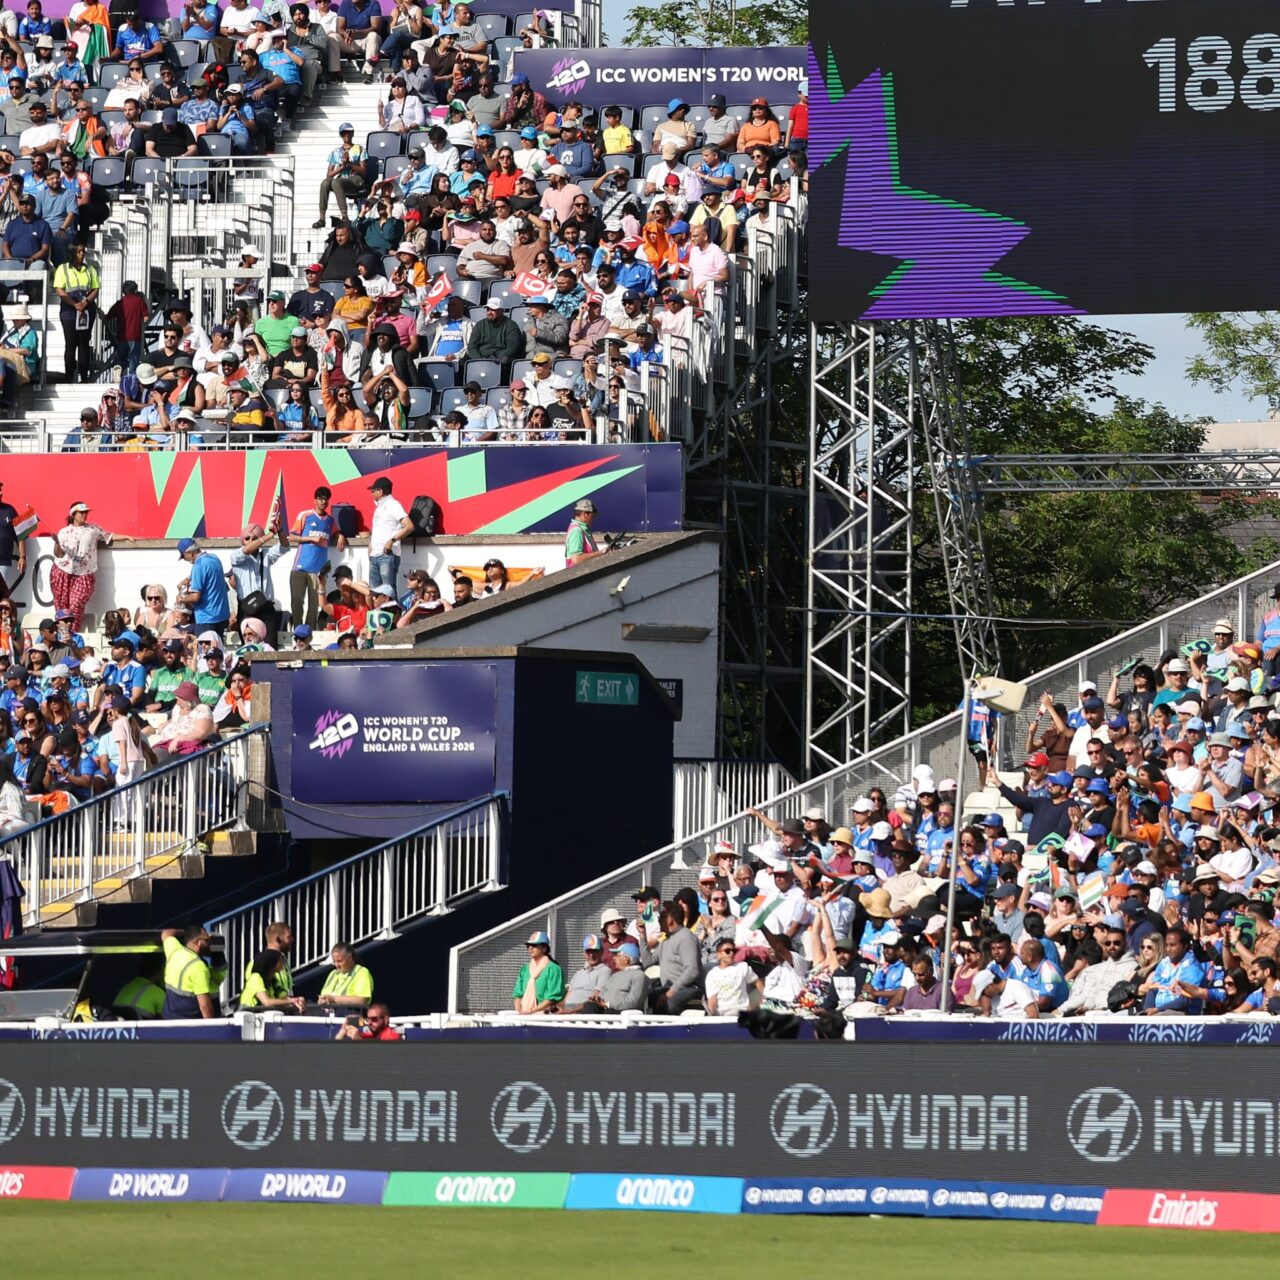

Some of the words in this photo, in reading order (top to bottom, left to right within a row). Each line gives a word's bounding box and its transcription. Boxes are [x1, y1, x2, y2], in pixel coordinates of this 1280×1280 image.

[596, 68, 626, 83] ICC
[630, 67, 717, 83] WOMEN'S
[720, 67, 751, 82] T20
[553, 417, 575, 429] Ford
[597, 679, 622, 697] EXIT
[363, 717, 380, 726] ICC
[382, 717, 428, 725] WOMEN'S
[430, 716, 448, 725] T20
[363, 727, 423, 742] WORLD
[428, 726, 461, 741] CUP
[363, 743, 407, 752] ENGLAND
[419, 743, 450, 752] WALES
[452, 742, 475, 751] 2026
[35, 1087, 190, 1139] HYUNDAI
[293, 1089, 458, 1142] HYUNDAI
[566, 1092, 736, 1147] HYUNDAI
[849, 1093, 1028, 1152] HYUNDAI
[108, 1173, 134, 1196] DP
[133, 1174, 189, 1197] WORLD
[260, 1173, 287, 1197] DP
[286, 1175, 346, 1199] WORLD
[435, 1176, 515, 1203] aramco
[616, 1177, 695, 1206] aramco
[1148, 1192, 1218, 1226] Emirates
